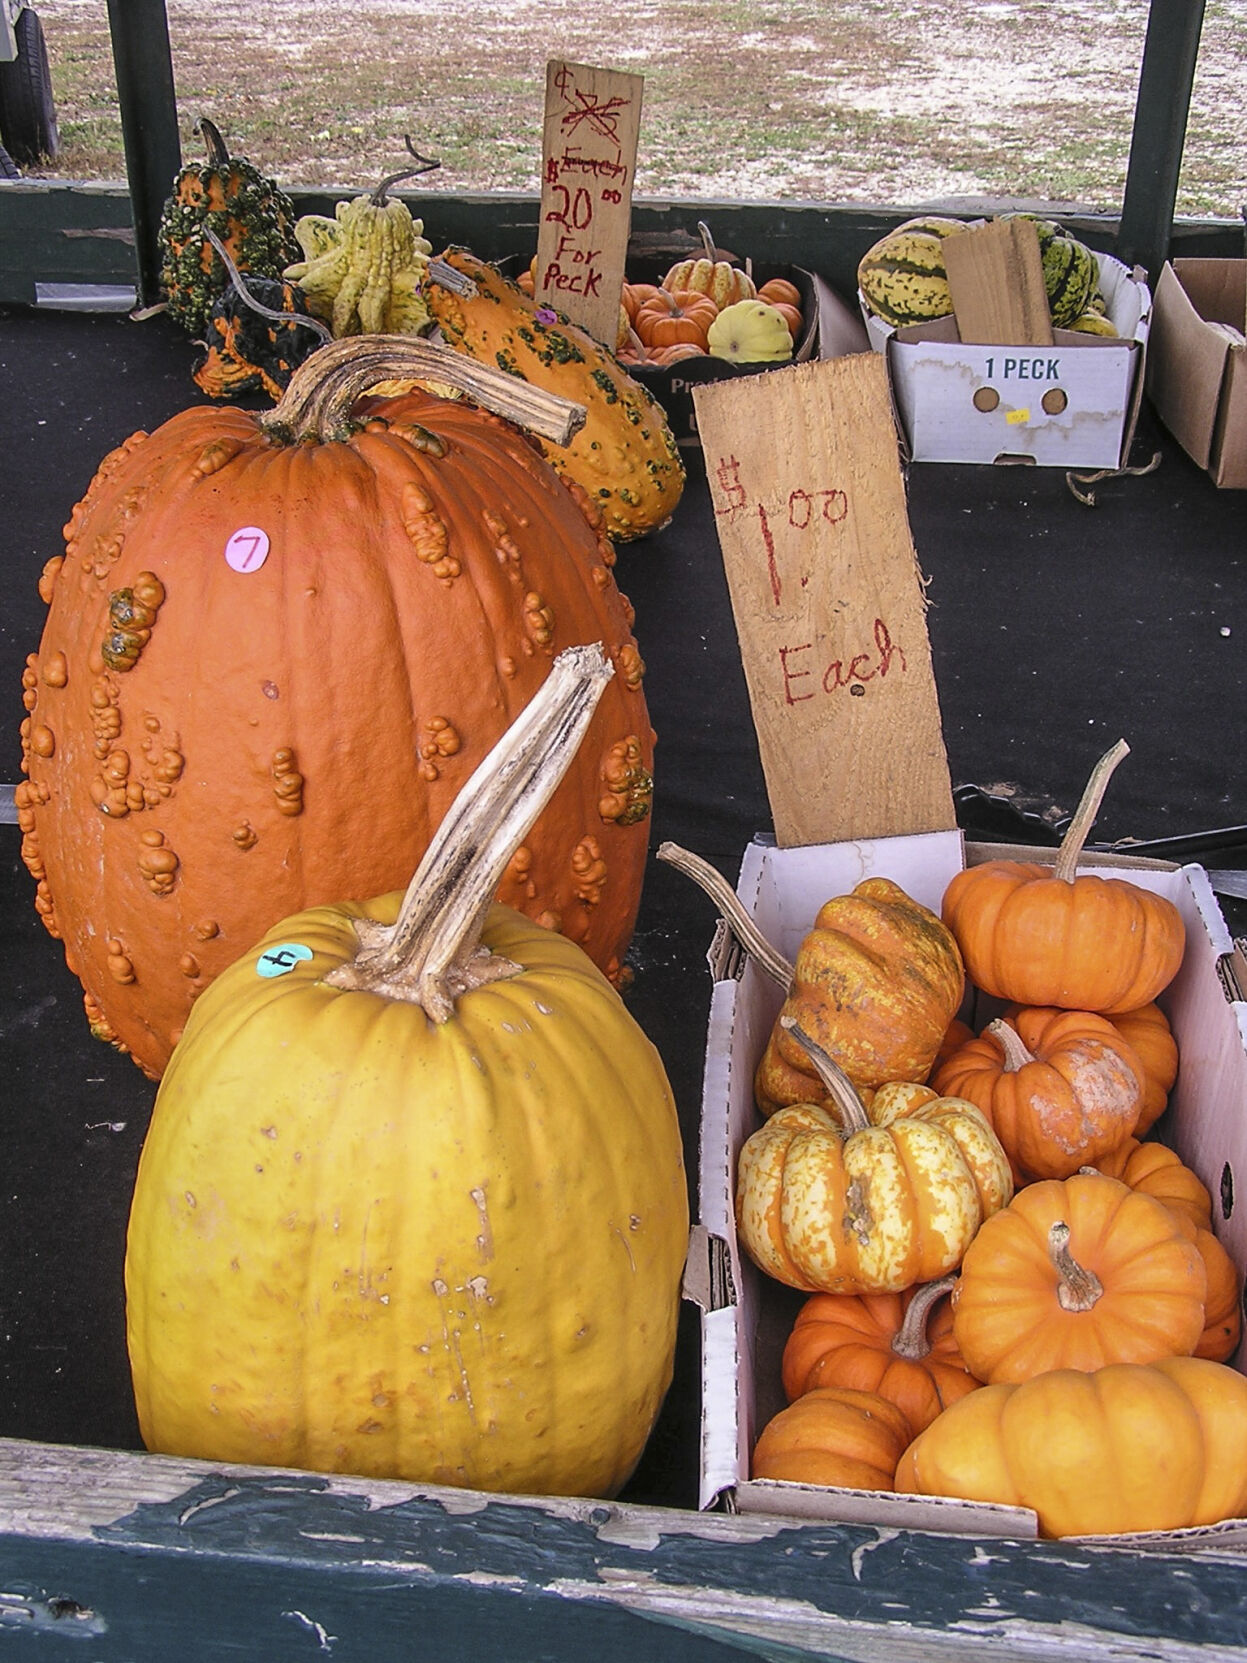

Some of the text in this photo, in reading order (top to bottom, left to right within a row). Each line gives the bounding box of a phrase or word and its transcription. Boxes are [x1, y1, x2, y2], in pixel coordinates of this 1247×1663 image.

[555, 236, 602, 265] For
[542, 262, 603, 298] Peck
[985, 357, 1061, 380] 1 PECK
[233, 534, 262, 569] 7
[777, 617, 909, 706] Each
[262, 949, 297, 968] 4
